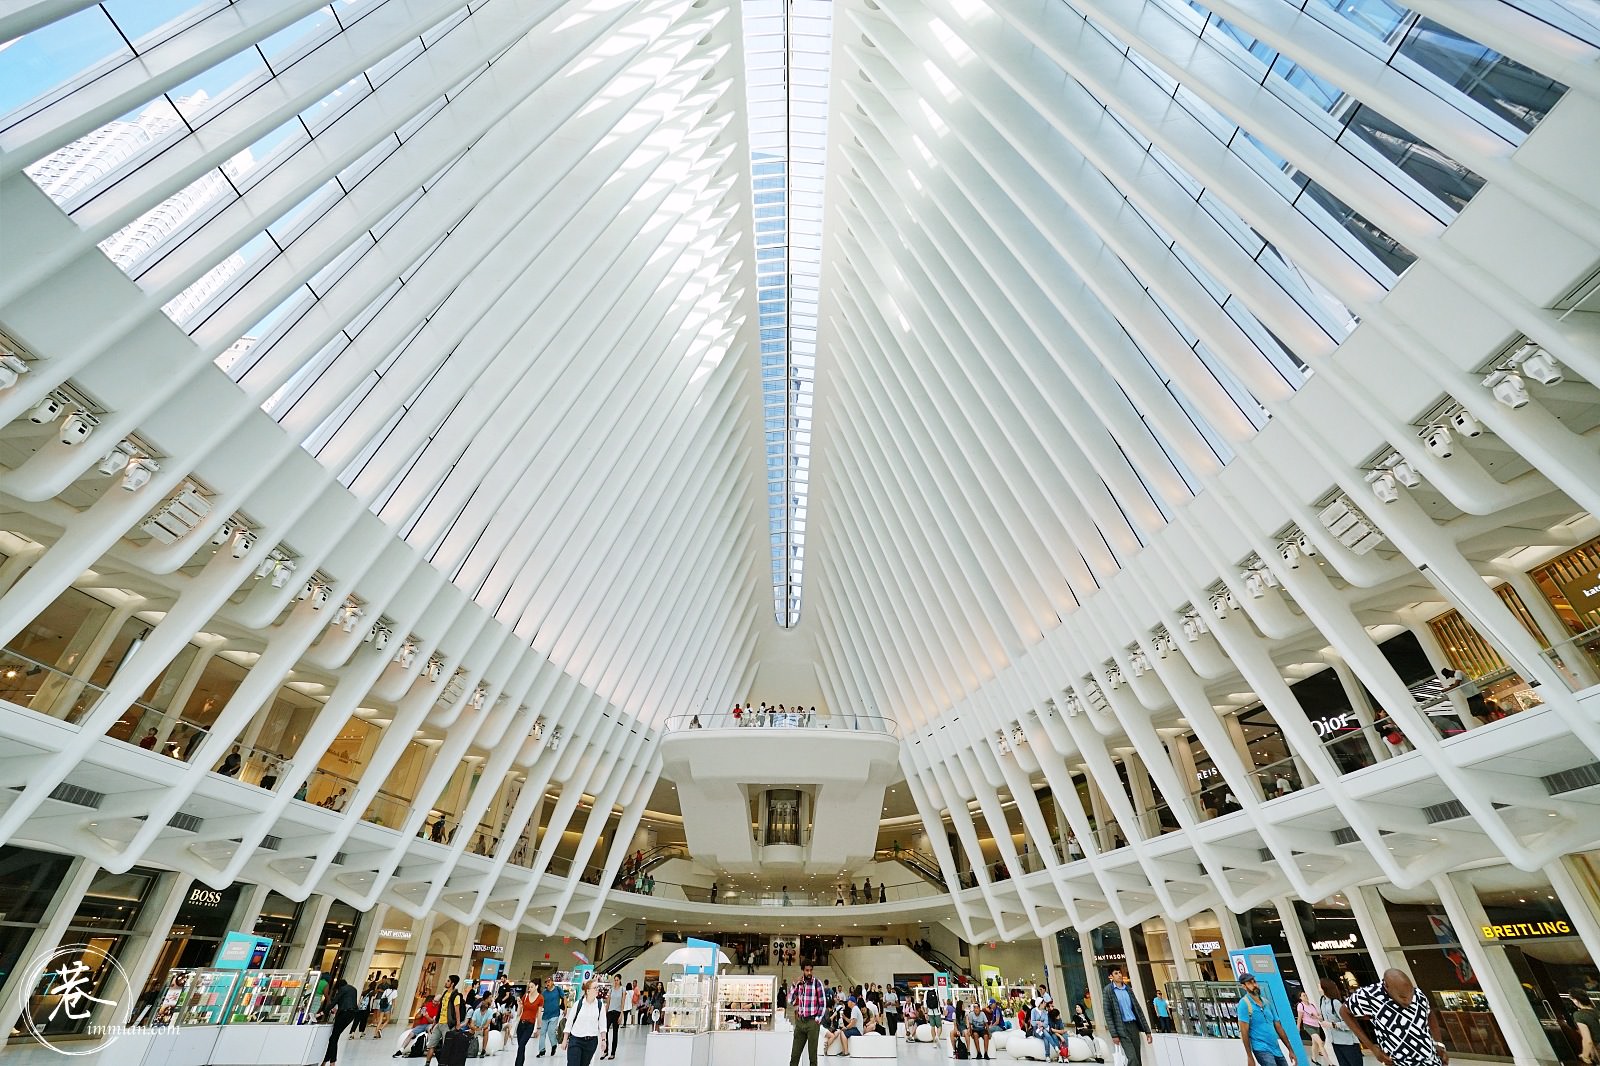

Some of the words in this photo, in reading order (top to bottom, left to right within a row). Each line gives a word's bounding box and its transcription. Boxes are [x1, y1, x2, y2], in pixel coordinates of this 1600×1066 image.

[190, 888, 222, 903] BOSS
[1481, 920, 1570, 938] BREITLING
[1311, 939, 1354, 950] MONTBLANC
[1094, 953, 1126, 961] SMYTHSON
